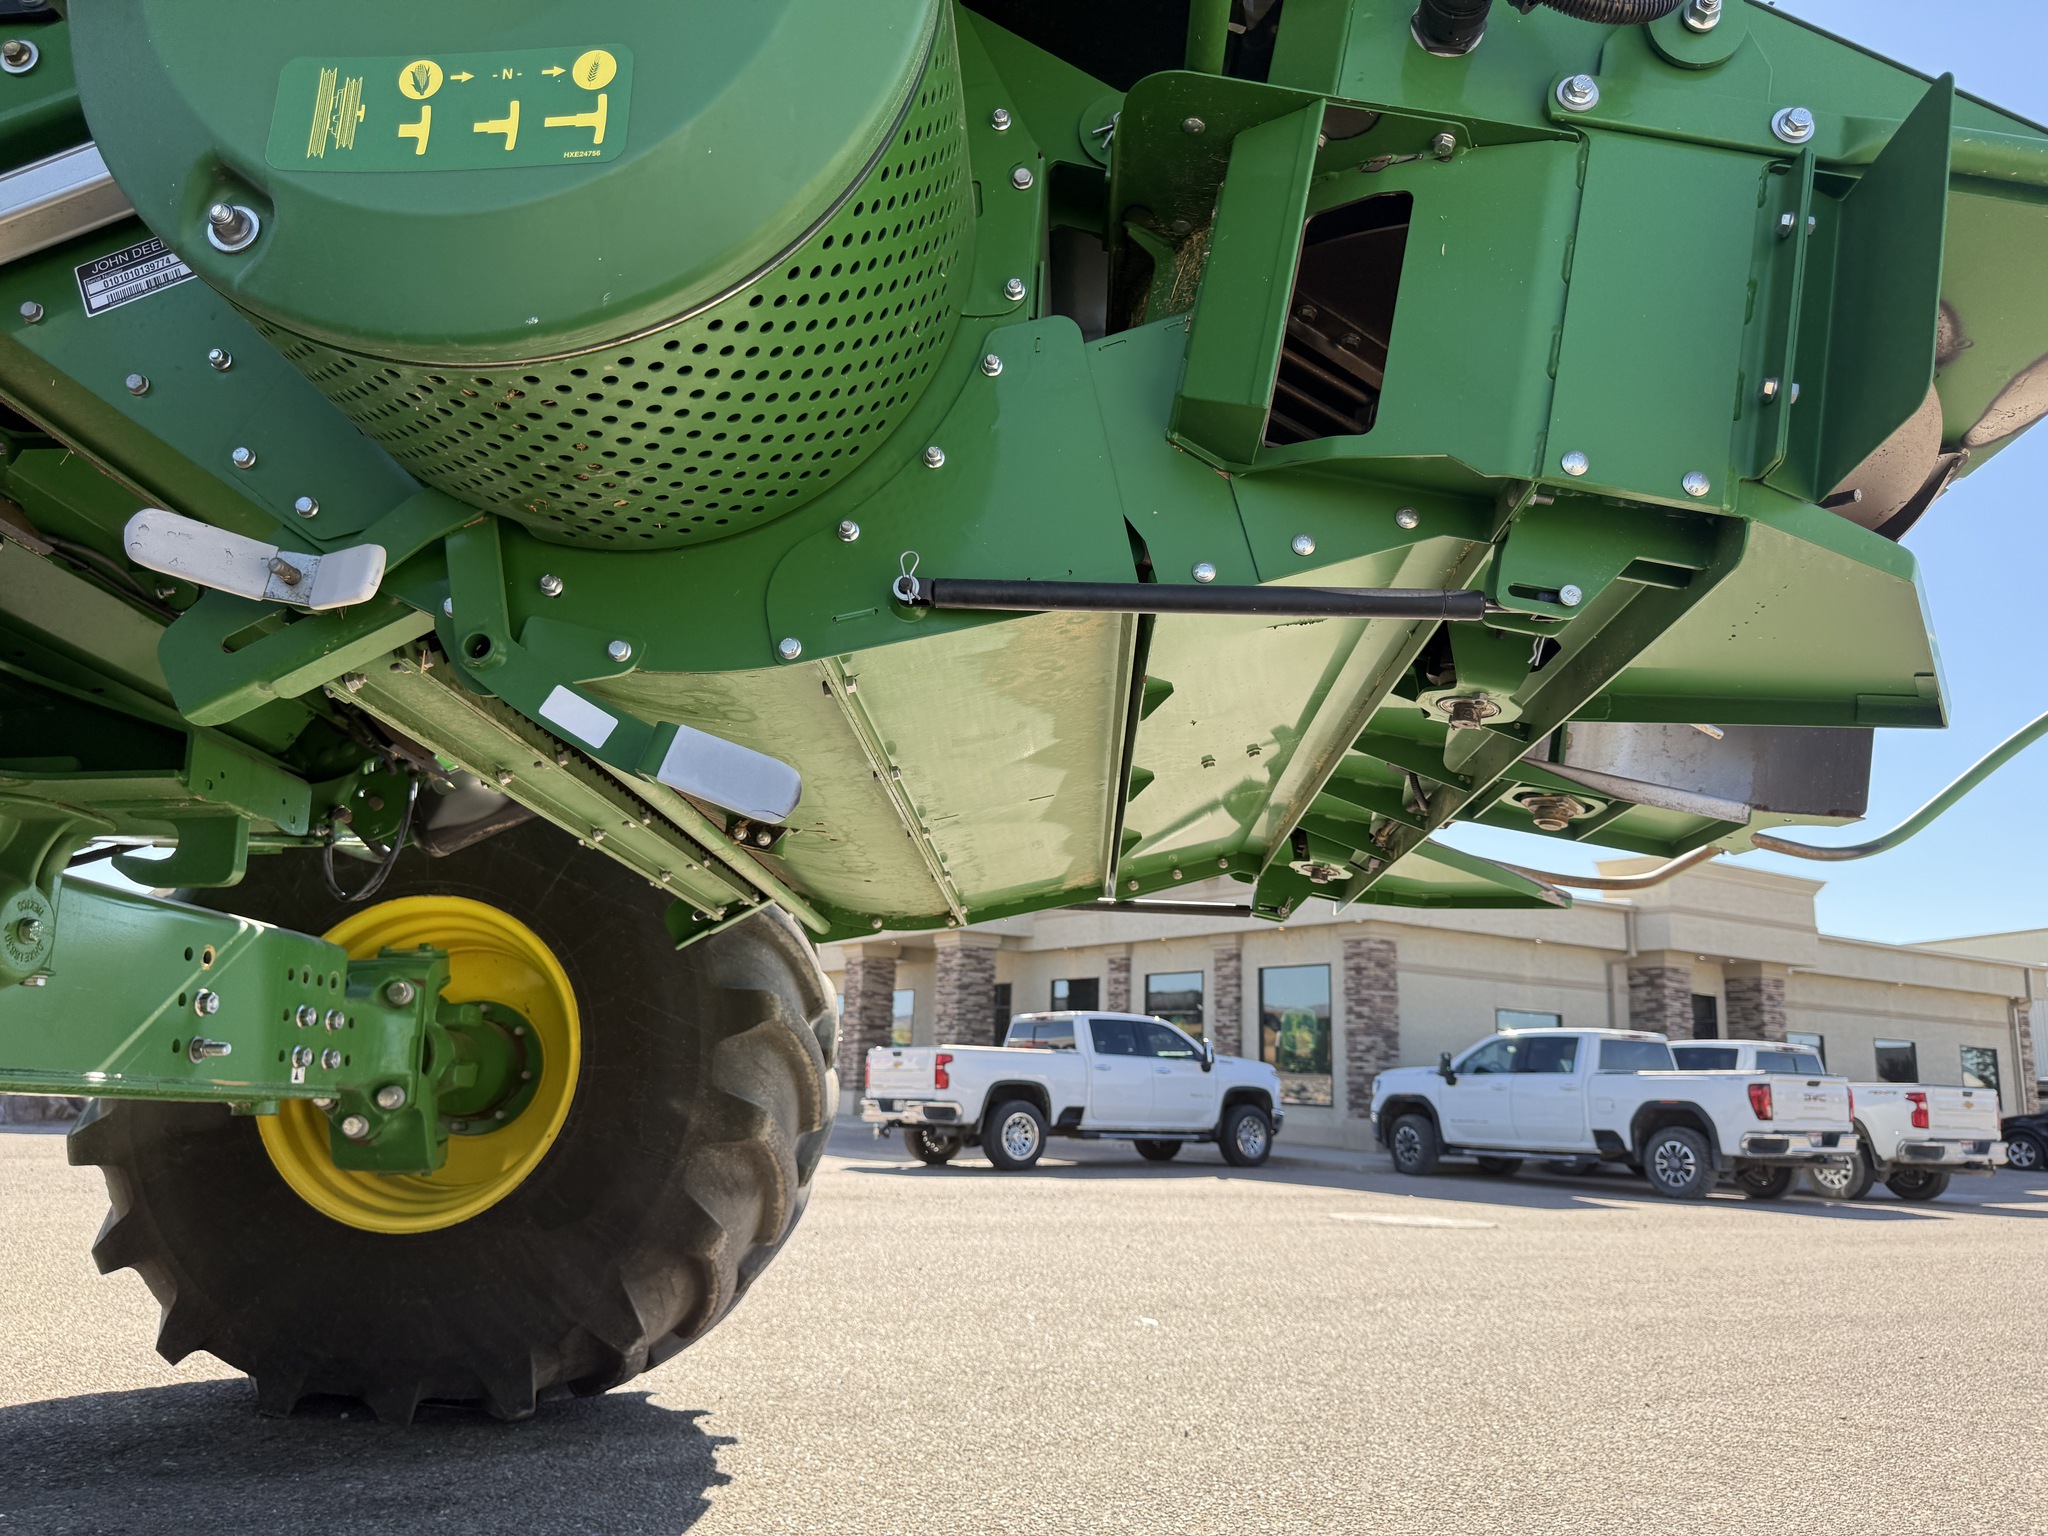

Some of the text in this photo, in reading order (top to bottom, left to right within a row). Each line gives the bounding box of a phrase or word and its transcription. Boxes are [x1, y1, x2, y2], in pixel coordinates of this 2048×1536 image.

[563, 150, 601, 159] HXE24756
[91, 252, 129, 274] JOHN
[102, 256, 171, 288] 0101010139774
[17, 900, 44, 916] MEXICO
